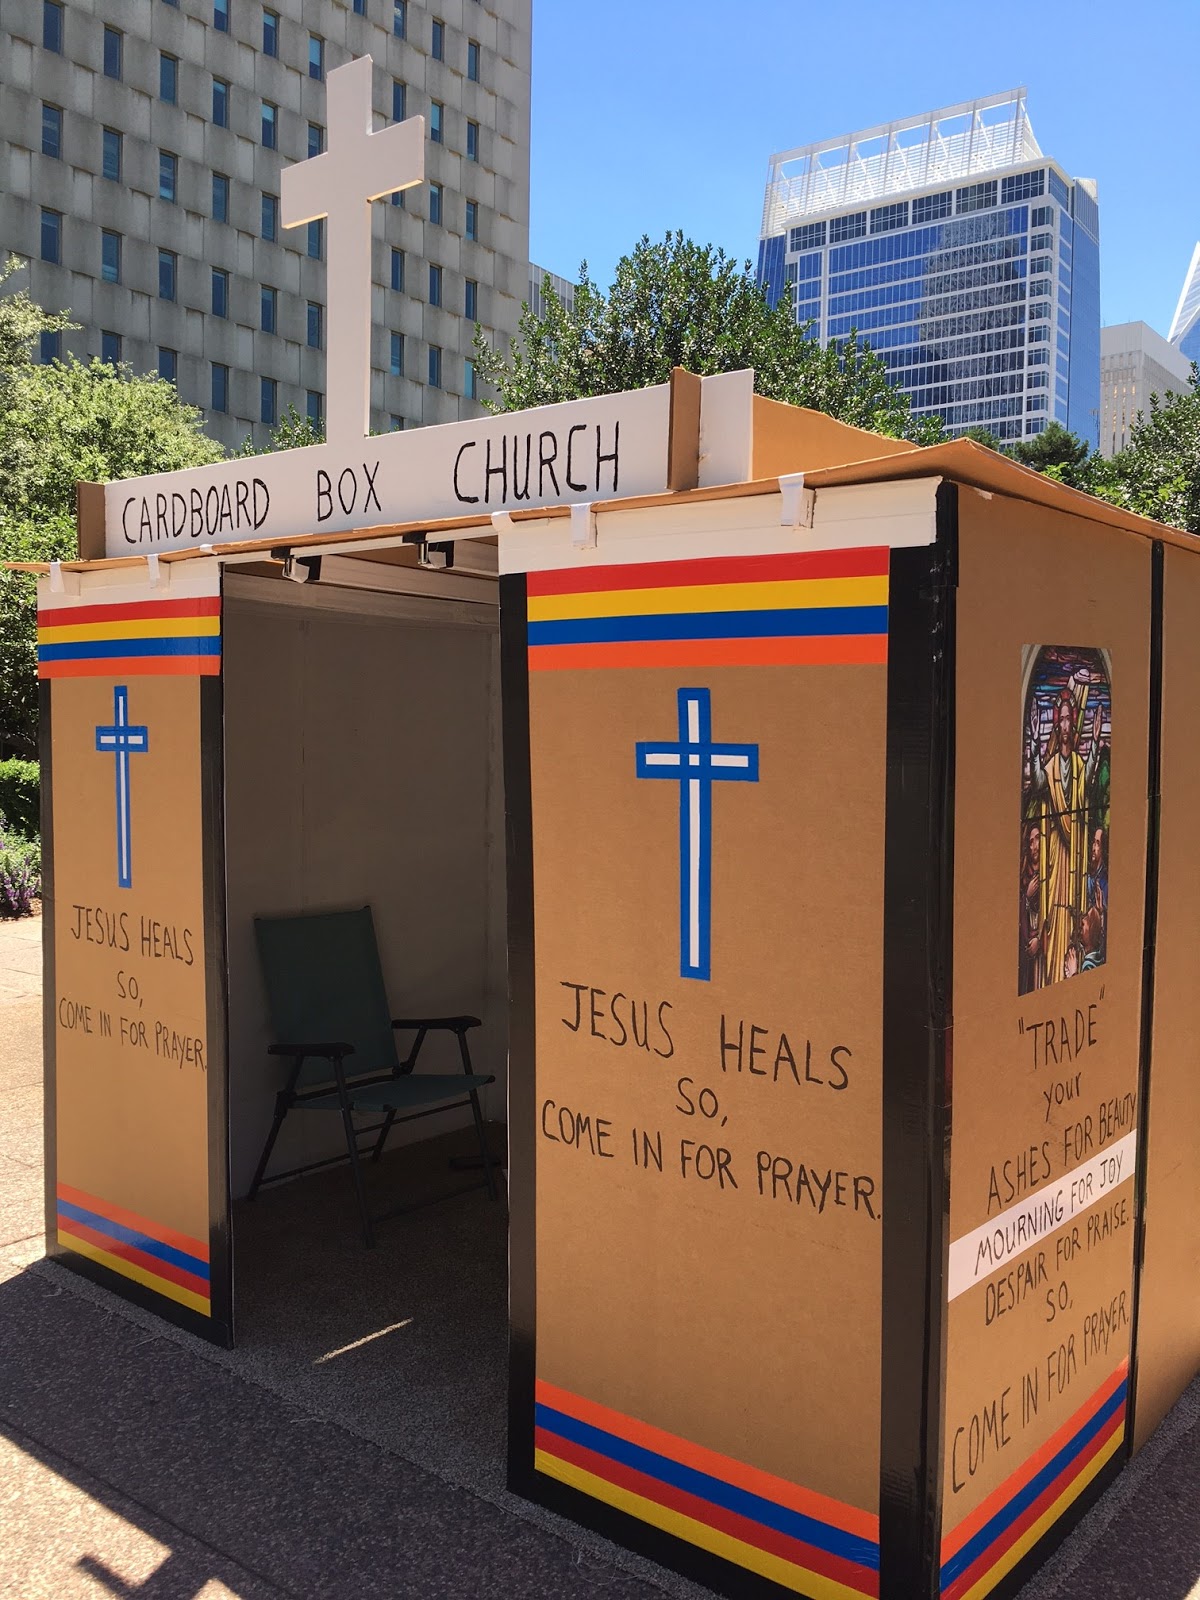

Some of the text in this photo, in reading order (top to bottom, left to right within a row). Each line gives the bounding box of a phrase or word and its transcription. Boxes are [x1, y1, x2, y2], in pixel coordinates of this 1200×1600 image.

[122, 420, 620, 544] CARDBOARD BOX CHURCH
[70, 904, 194, 966] JESUS HEALS
[58, 997, 93, 1034] COME
[99, 1010, 112, 1037] IN
[120, 1016, 149, 1049] FOR
[116, 970, 143, 1008] SO,
[560, 981, 852, 1090] JESUS HEALS
[676, 1077, 728, 1127] SO,
[1043, 1072, 1082, 1122] your
[542, 1099, 614, 1158] COME
[632, 1127, 663, 1172] IN
[680, 1139, 738, 1189] FOR
[986, 1092, 1137, 1215] ASHES FOR BEAUTY
[974, 1149, 1123, 1276] MOURNING FOR JOY
[985, 1251, 1048, 1326] DESPAIR
[1056, 1226, 1081, 1272] FOR
[1046, 1280, 1074, 1323] SO,
[952, 1386, 1012, 1494] COME
[1022, 1367, 1038, 1429] IN
[1047, 1333, 1078, 1403] FOR
